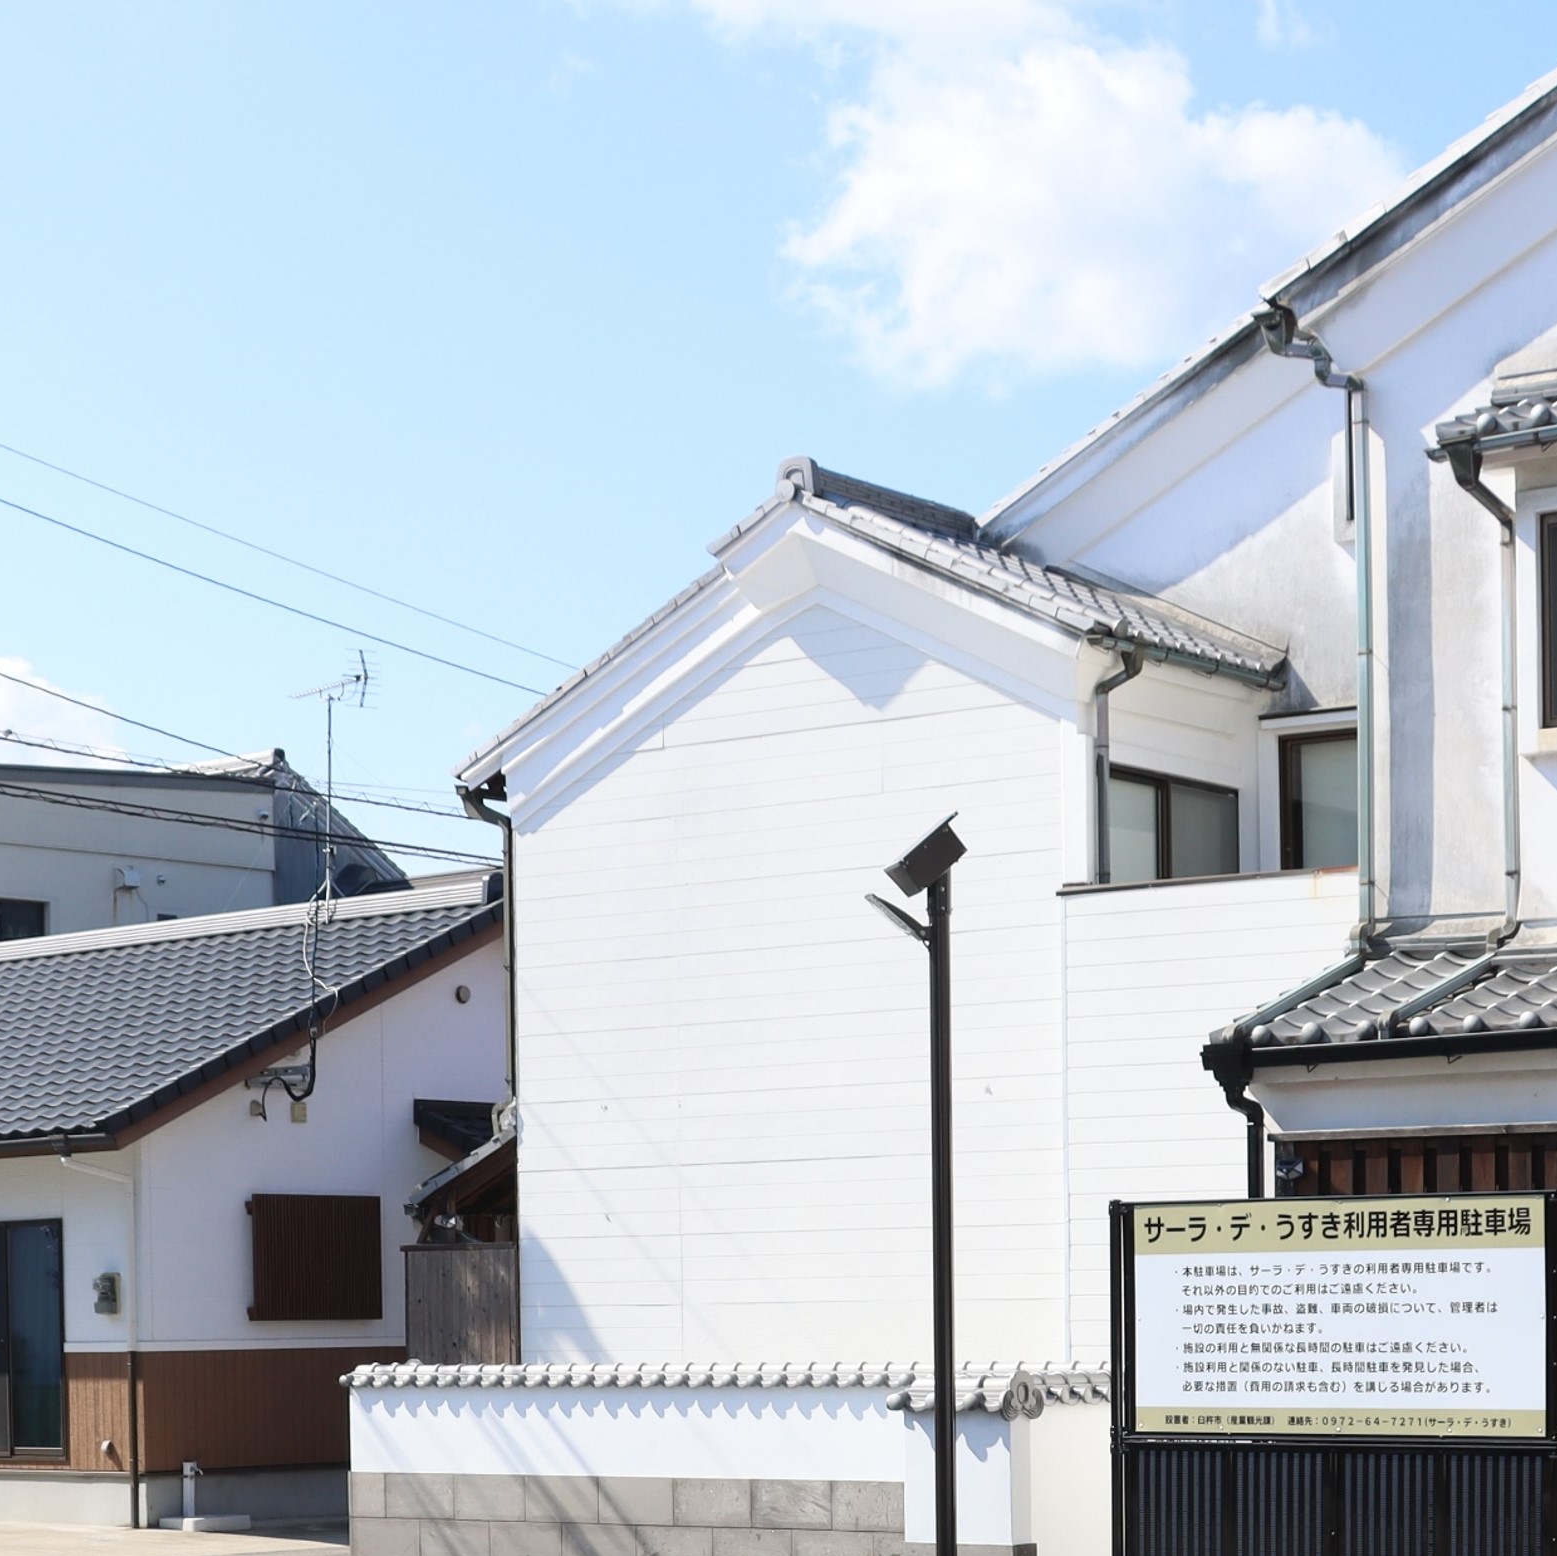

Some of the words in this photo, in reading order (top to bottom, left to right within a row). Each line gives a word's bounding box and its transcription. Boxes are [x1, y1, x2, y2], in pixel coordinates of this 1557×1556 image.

[1144, 1206, 1532, 1243] サーラ・デ・うすき利用者専用駐車場
[1182, 1283, 1418, 1297] それ以外の目的でのご利用はご遠慮ください。
[1182, 1322, 1324, 1335] 一切の責任を負いかねます。
